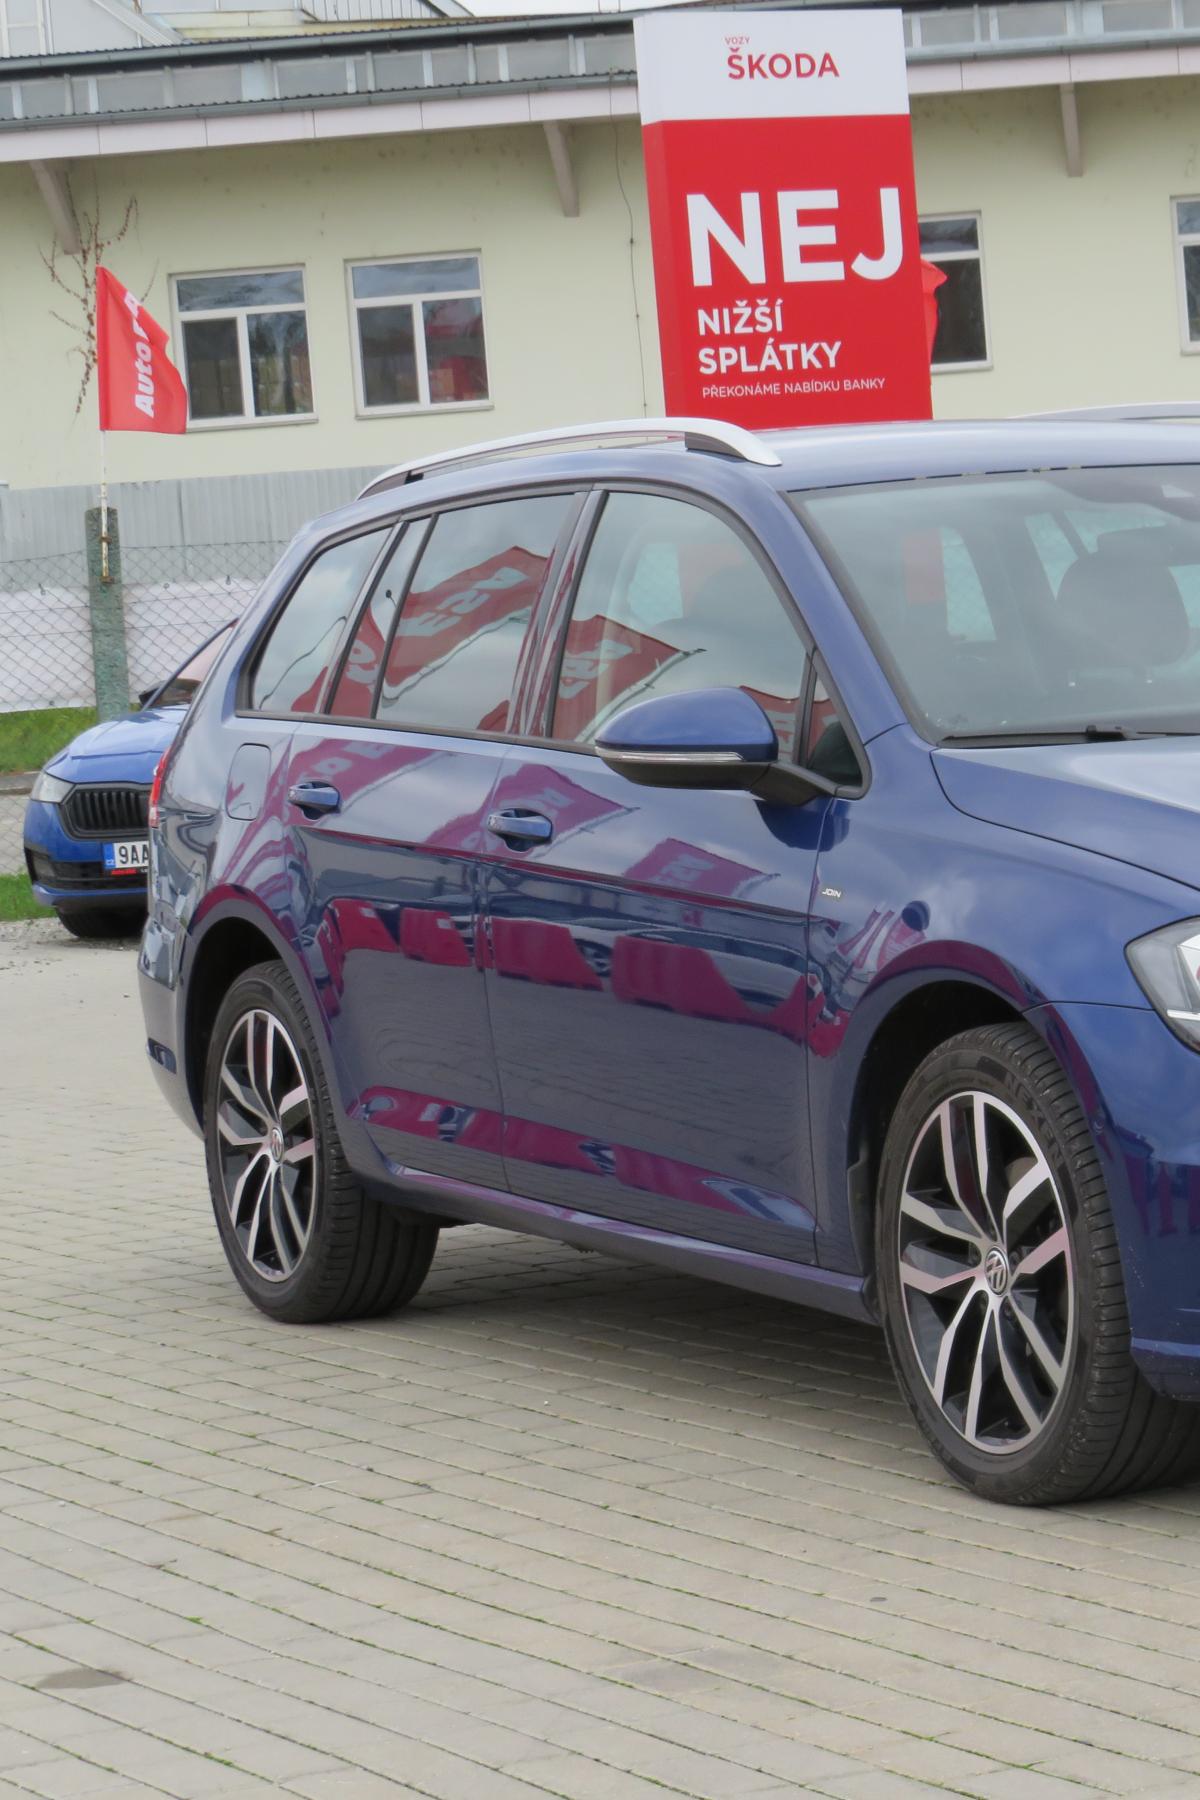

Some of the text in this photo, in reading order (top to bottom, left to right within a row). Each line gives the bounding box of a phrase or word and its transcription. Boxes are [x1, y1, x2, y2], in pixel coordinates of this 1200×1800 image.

[724, 36, 751, 46] VOZY
[727, 47, 841, 80] ŠKODA
[686, 187, 904, 287] NEJ
[697, 298, 784, 336] NIŽŠÍ
[698, 337, 842, 375] SPLÁTKY
[135, 341, 155, 419] Auto
[702, 377, 886, 399] PŘEKONÁME NABÍDKU BANKY
[822, 888, 841, 898] JOIN
